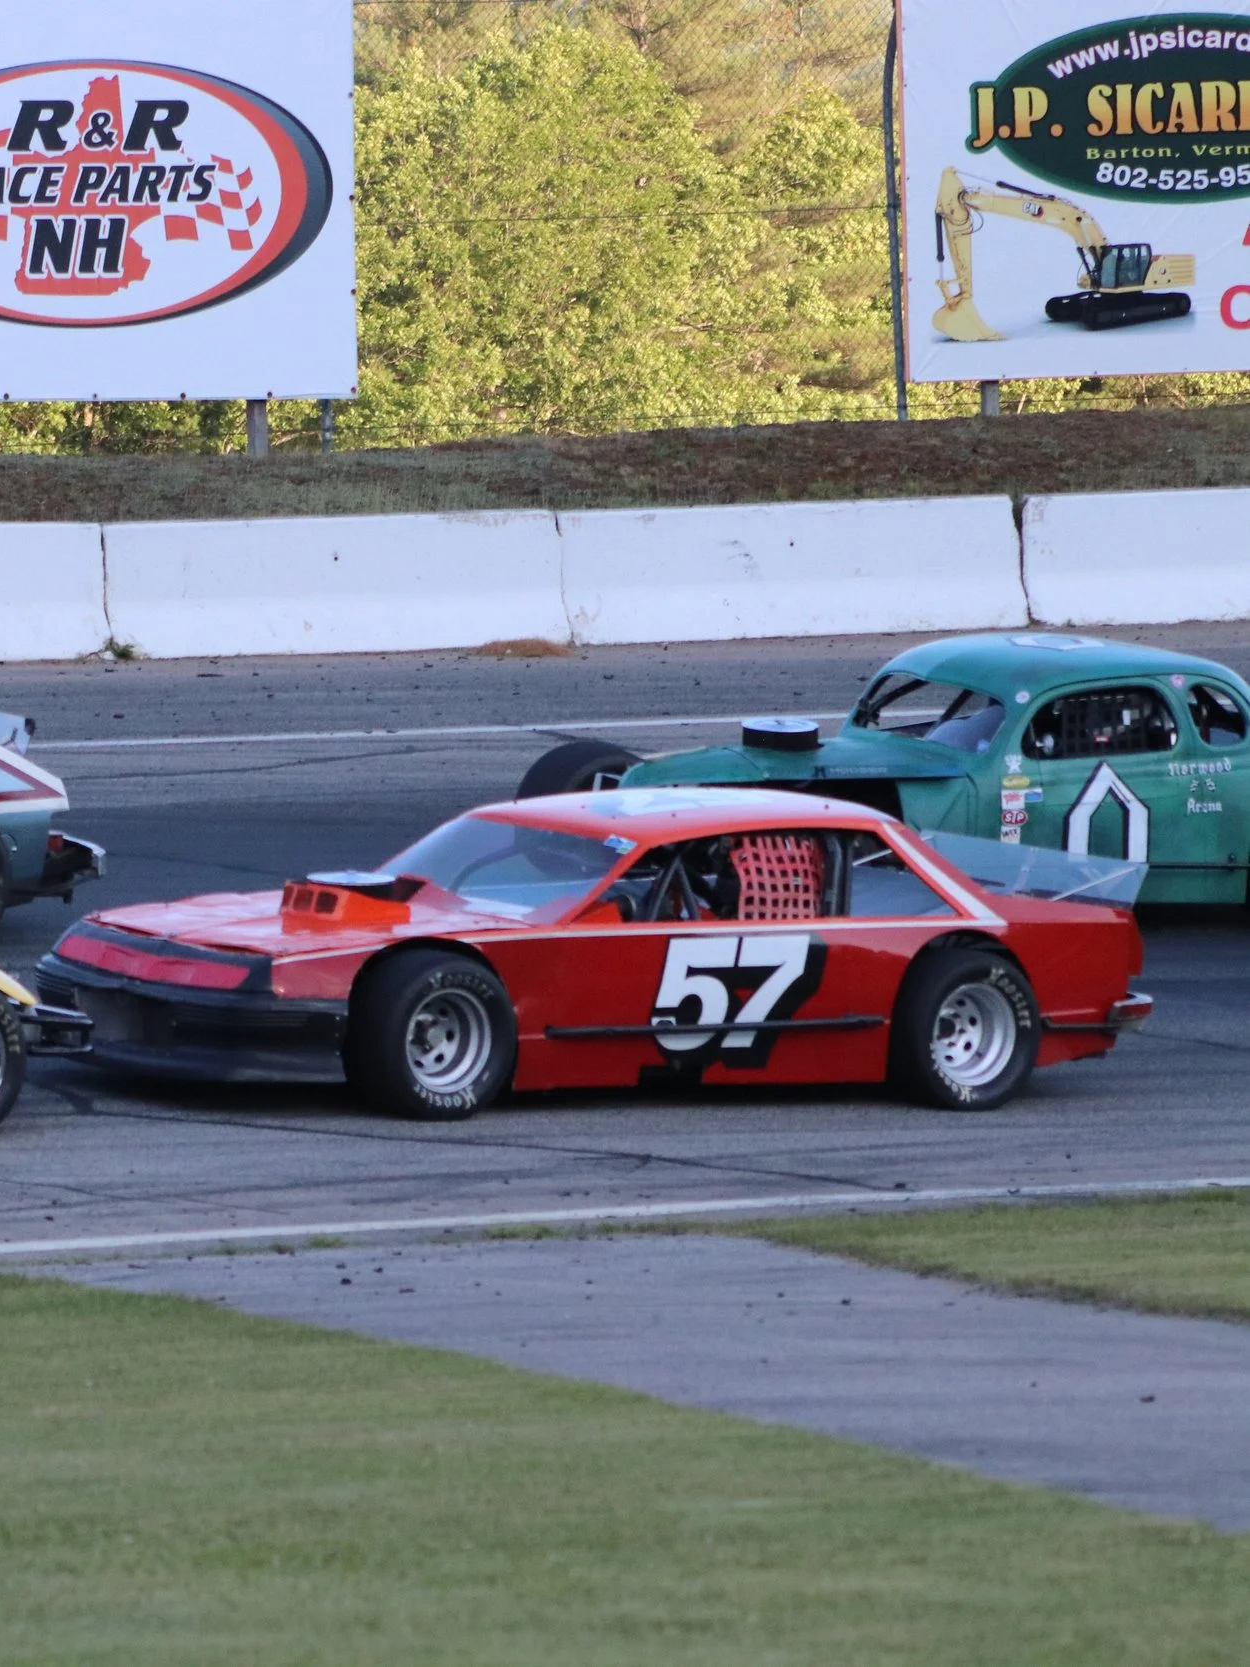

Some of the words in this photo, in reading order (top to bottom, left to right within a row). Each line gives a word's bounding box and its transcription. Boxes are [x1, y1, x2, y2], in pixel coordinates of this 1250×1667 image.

[972, 86, 1063, 148] J.P.
[1086, 146, 1180, 160] Barton,
[72, 164, 217, 203] PARTS
[1096, 162, 1250, 191] 802-525-95
[28, 217, 126, 275] NH
[1004, 811, 1025, 823] STP
[651, 935, 811, 1051] 57
